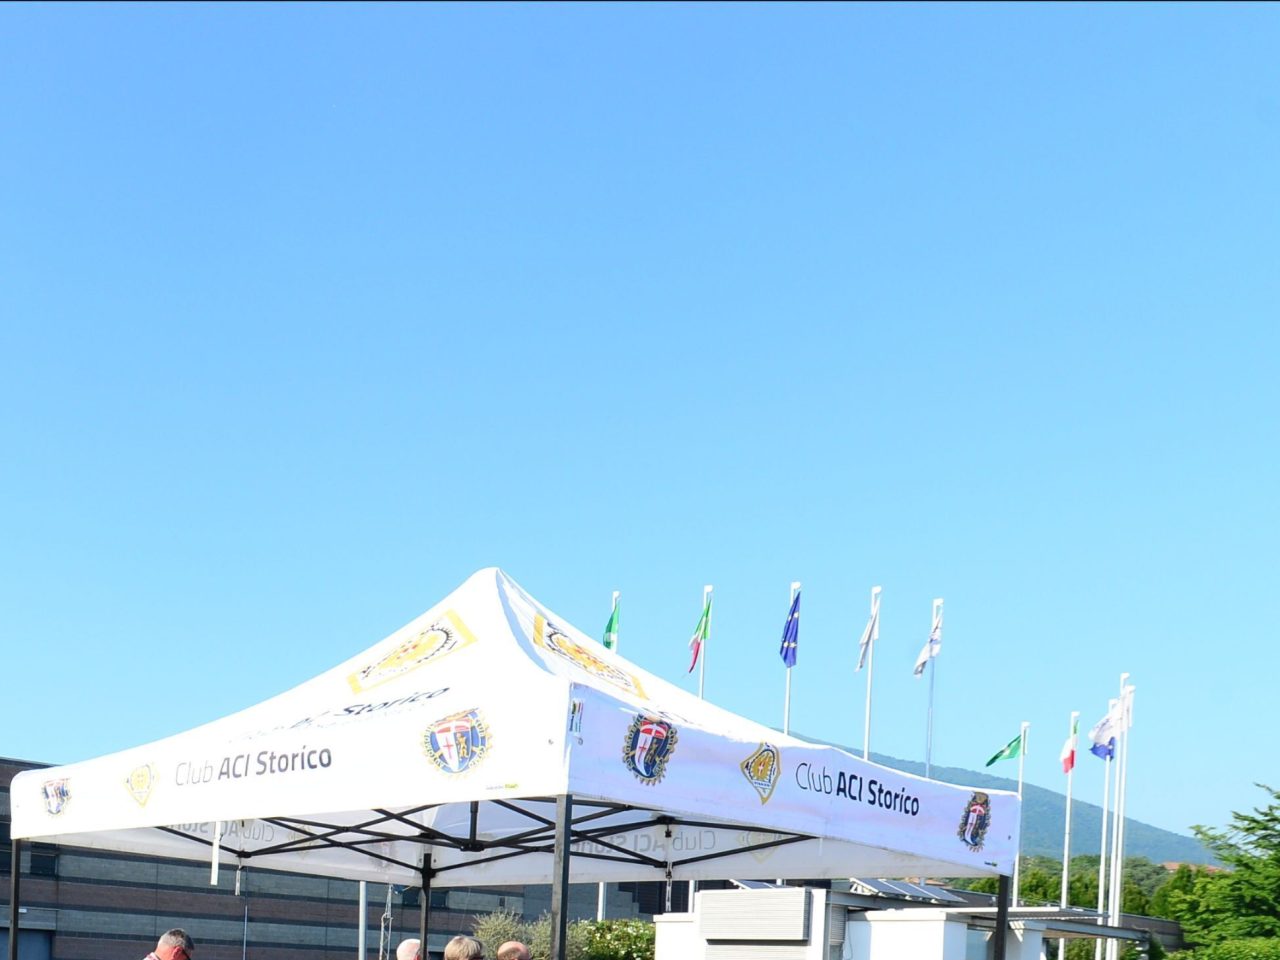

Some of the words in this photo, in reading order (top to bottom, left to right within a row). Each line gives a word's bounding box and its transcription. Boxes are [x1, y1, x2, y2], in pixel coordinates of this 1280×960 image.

[175, 760, 214, 786] Club
[218, 753, 251, 780] ACI
[256, 745, 332, 776] Storico
[795, 762, 833, 795] Club
[836, 771, 863, 802] ACI
[867, 779, 920, 817] Storico
